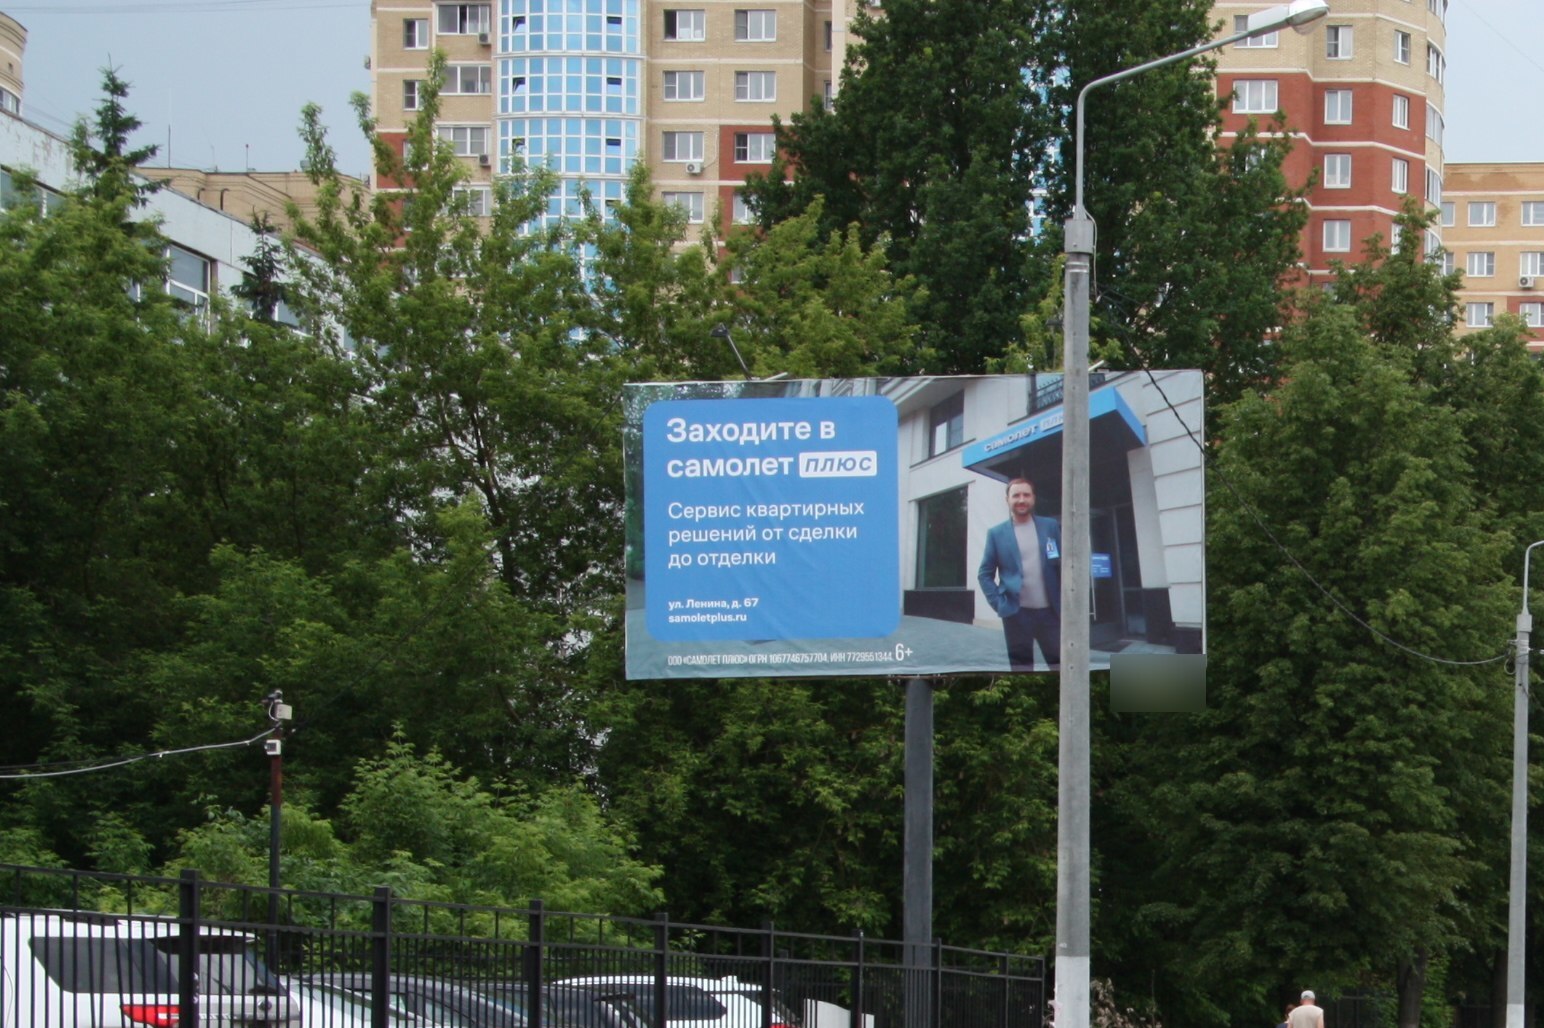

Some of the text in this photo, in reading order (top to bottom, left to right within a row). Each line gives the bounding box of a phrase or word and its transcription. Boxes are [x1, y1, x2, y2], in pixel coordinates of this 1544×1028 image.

[666, 417, 836, 445] Заходите в
[667, 457, 872, 478] самолет плюс
[668, 502, 865, 522] Сервис квартирных
[668, 525, 858, 547] решений от сделки
[668, 552, 776, 569] до отделки
[668, 598, 759, 611] ул. Ленина, д. 67
[668, 613, 748, 624] samoletplus.ru
[667, 655, 683, 666] ООО
[683, 654, 721, 665] «САМОЛЕТ
[748, 653, 768, 664] ОГРН
[830, 652, 846, 663] ИНН
[895, 643, 913, 661] 6+
